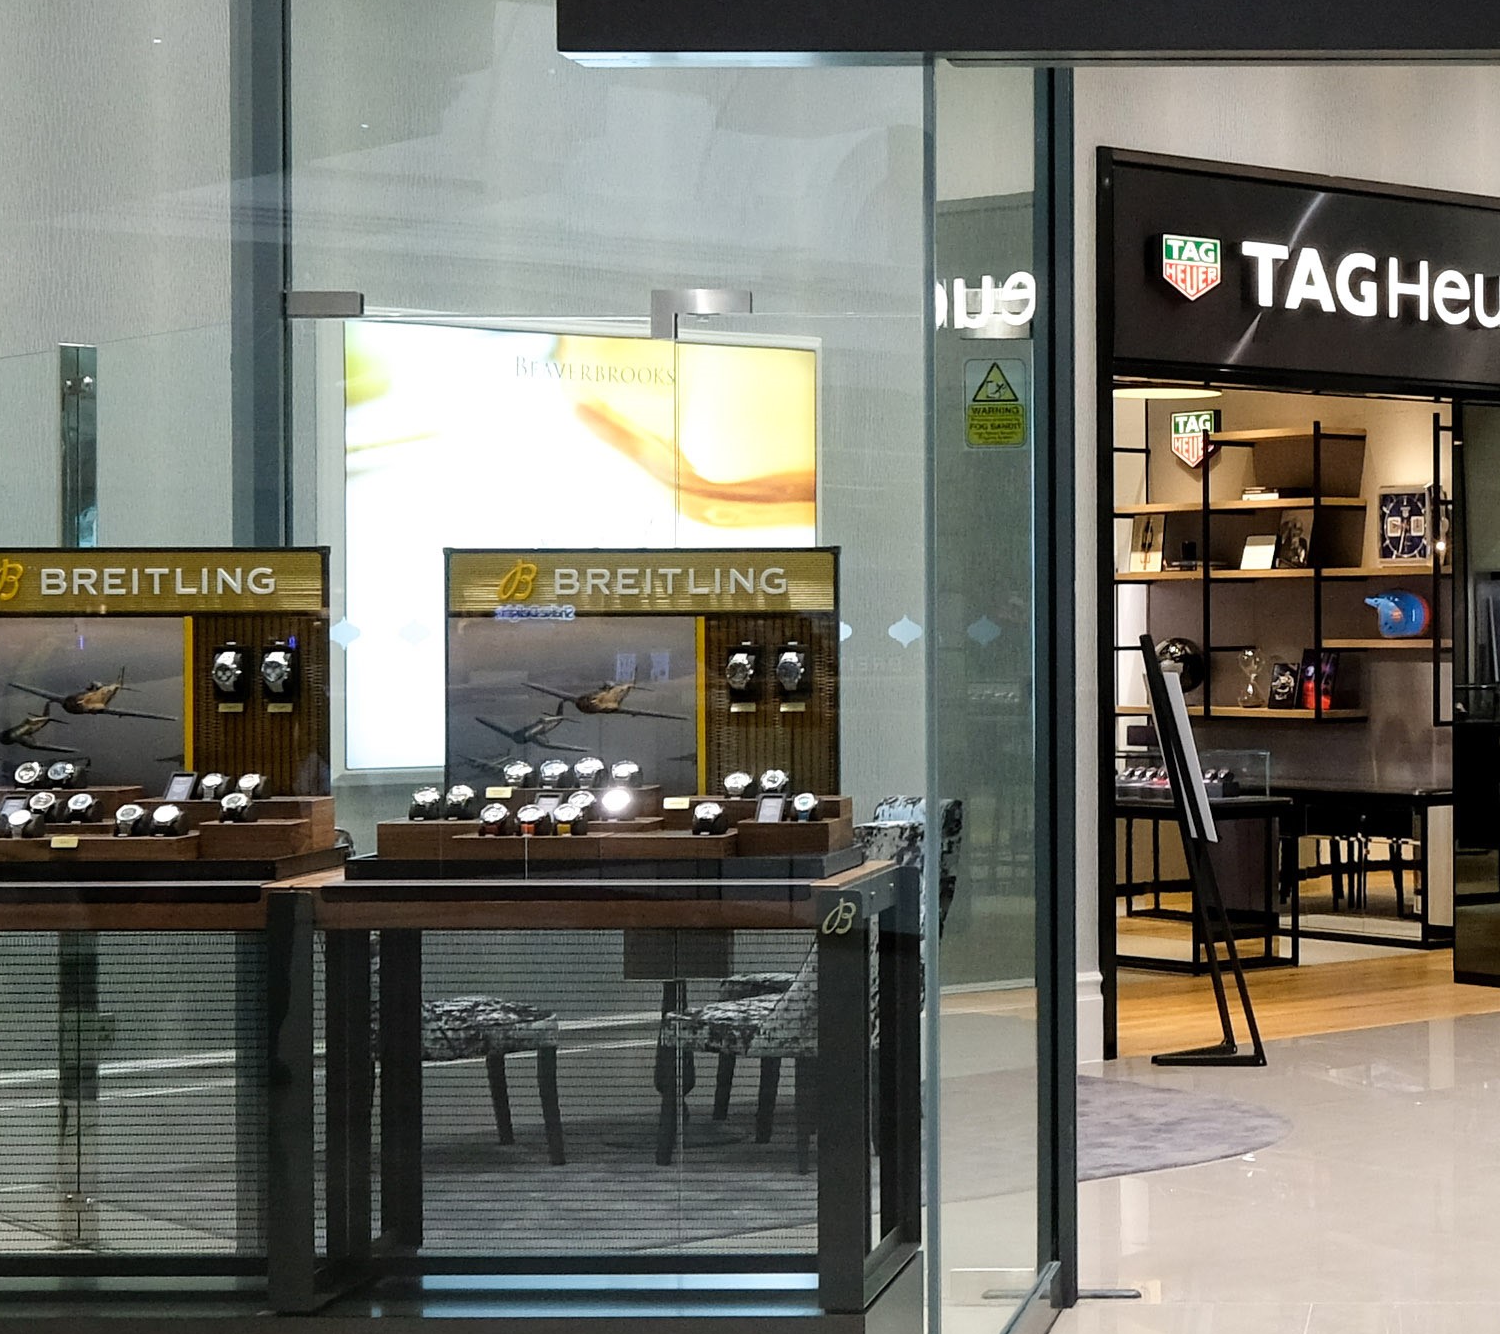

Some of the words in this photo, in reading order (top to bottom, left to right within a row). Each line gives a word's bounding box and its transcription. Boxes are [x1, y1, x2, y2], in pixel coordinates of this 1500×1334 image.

[1167, 240, 1215, 263] TAG
[1166, 264, 1217, 295] HEUER
[515, 355, 676, 387] BEAVERBROOKS
[40, 567, 277, 596] BREITLING
[553, 567, 788, 596] BREITLING
